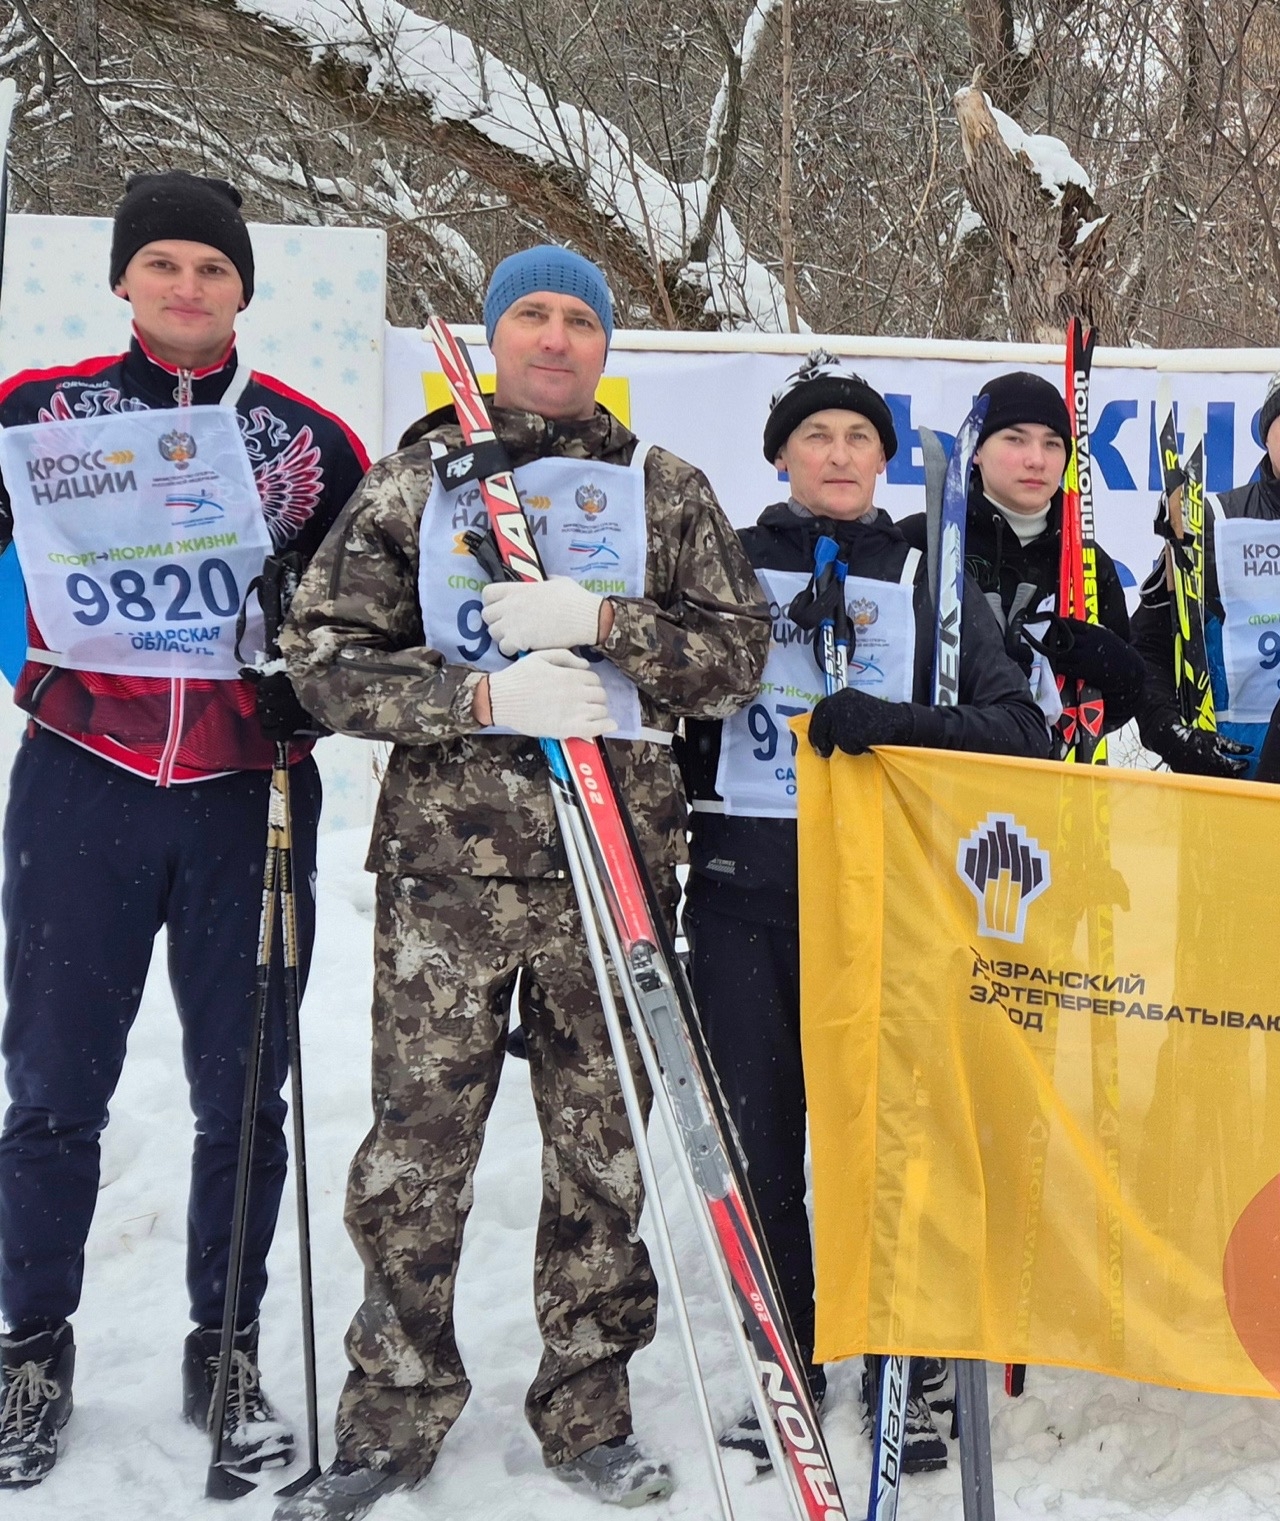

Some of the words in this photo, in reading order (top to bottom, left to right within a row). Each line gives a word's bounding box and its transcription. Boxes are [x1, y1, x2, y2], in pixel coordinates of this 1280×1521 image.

[26, 449, 106, 482] КРОСС
[31, 470, 138, 506] НАЦИИ
[48, 552, 97, 567] СПОРТ
[109, 543, 174, 562] НОРМА
[176, 532, 238, 554] ЖИЗНИ
[66, 558, 240, 626] 9820
[578, 762, 604, 806] 200
[968, 946, 1146, 995] ЫЗРАНСКИЙ
[750, 1292, 769, 1323] 200
